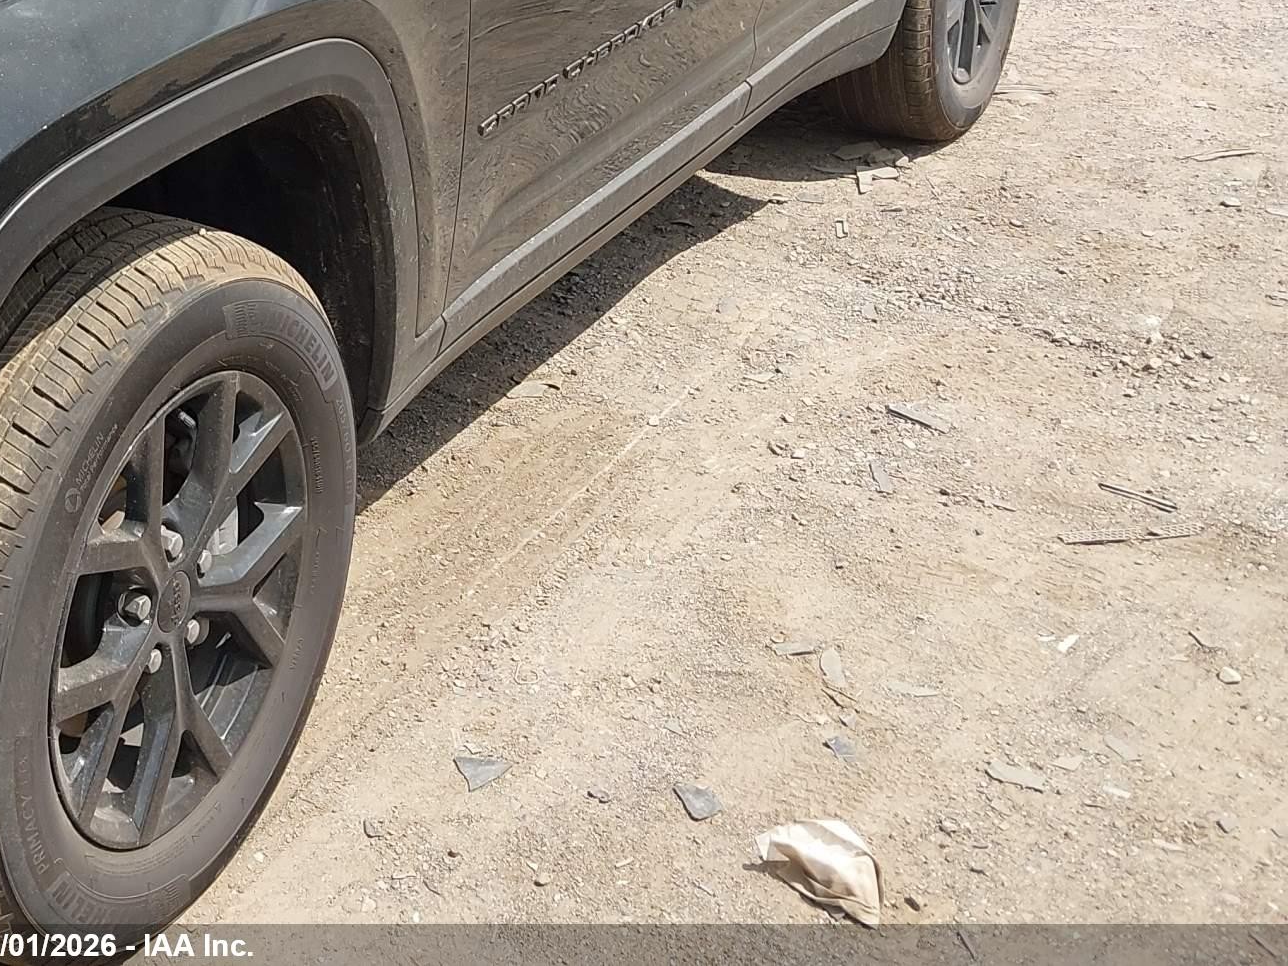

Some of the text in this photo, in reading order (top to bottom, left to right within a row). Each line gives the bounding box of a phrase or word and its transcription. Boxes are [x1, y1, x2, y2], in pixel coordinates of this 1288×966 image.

[264, 310, 337, 387] MICHELIN
[74, 431, 105, 485] MICHELIN
[20, 794, 50, 876] PRIMACY
